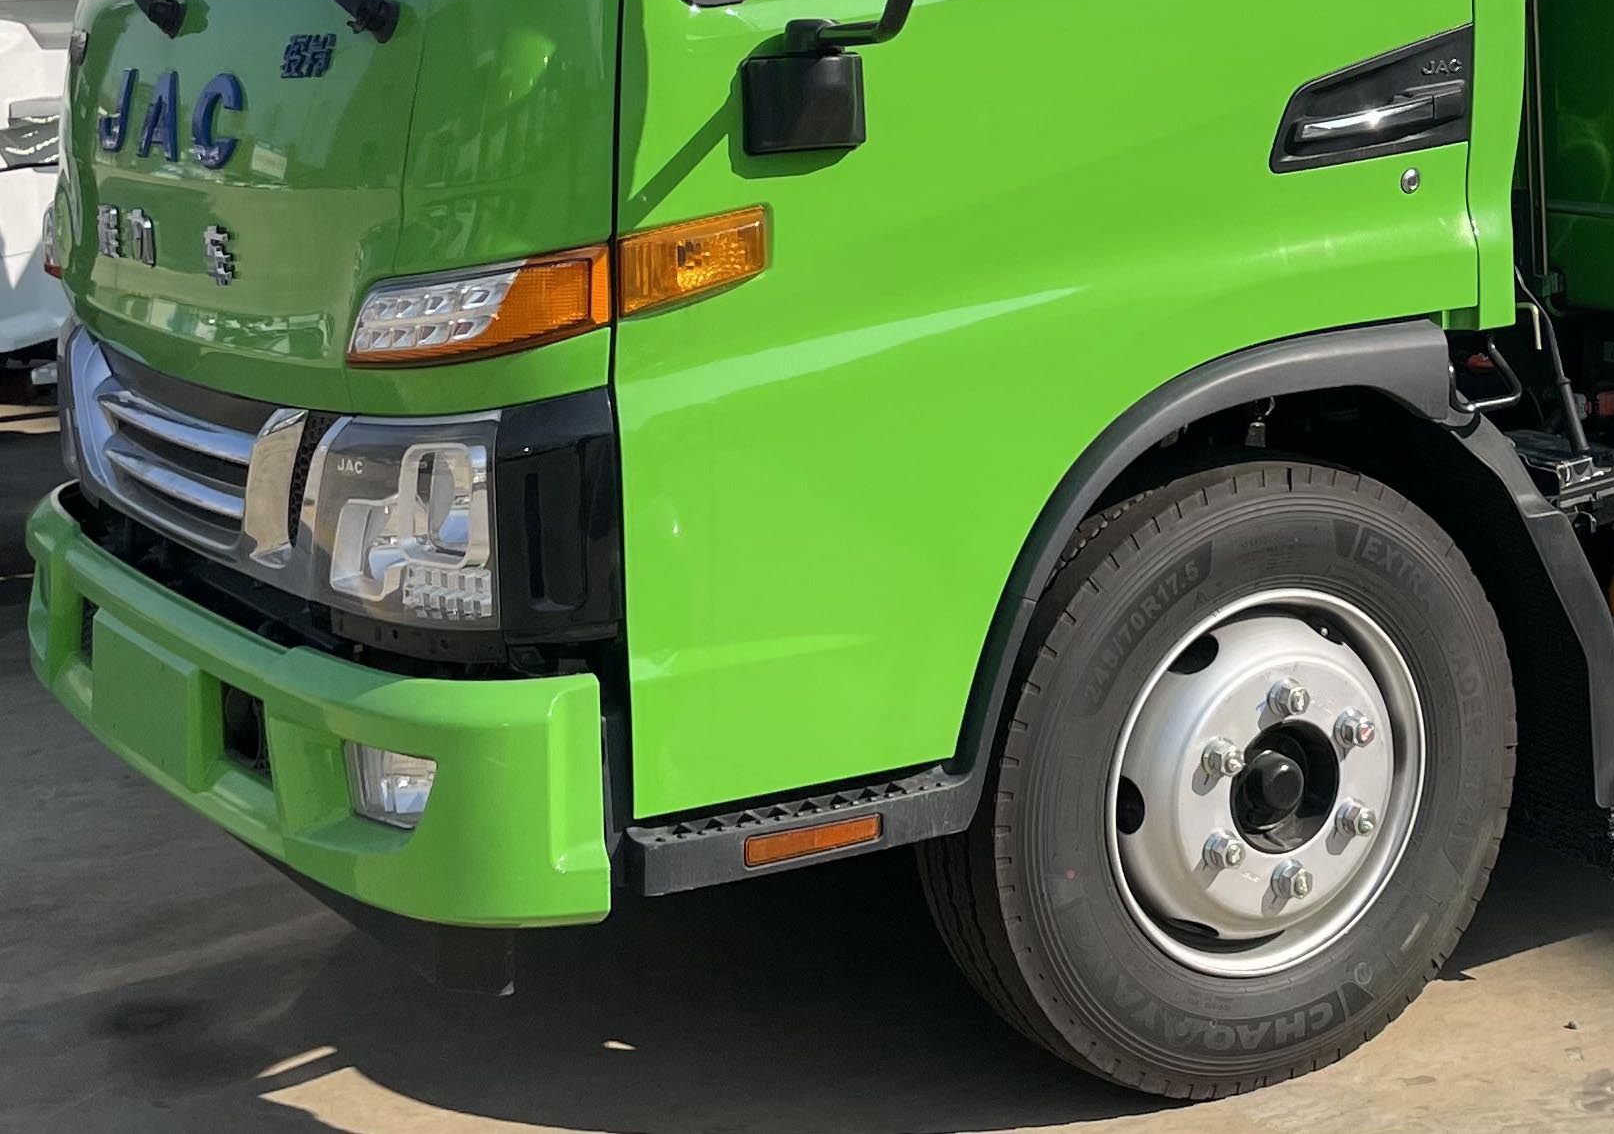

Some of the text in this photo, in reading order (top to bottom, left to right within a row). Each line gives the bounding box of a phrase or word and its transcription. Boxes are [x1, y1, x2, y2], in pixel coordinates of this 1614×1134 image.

[1421, 58, 1463, 75] JAC
[98, 68, 243, 170] JAC
[337, 458, 363, 474] JAC
